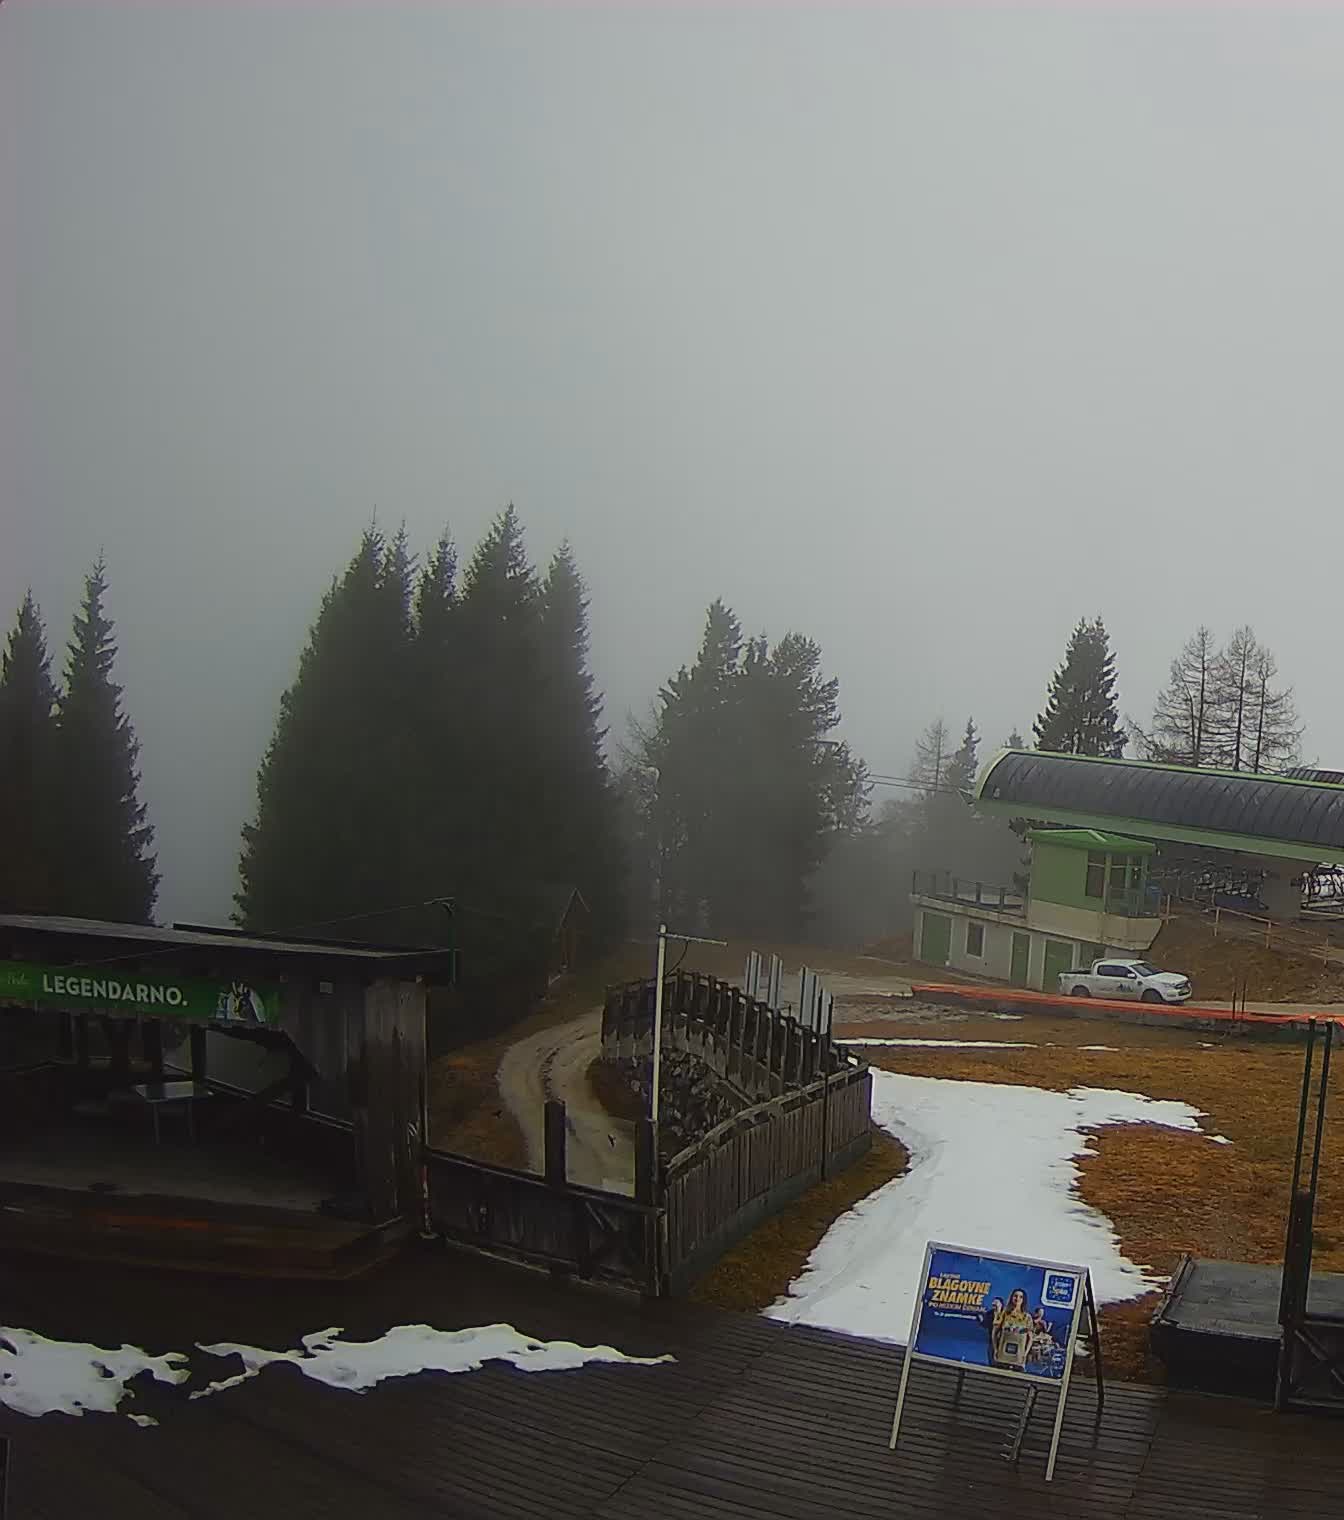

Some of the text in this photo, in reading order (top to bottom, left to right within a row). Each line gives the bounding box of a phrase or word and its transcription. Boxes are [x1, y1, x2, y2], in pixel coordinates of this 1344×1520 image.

[43, 973, 188, 1006] LEGENDARNO.
[928, 1276, 992, 1295] BLAGOVNE
[931, 1289, 985, 1306] ZNAMKE
